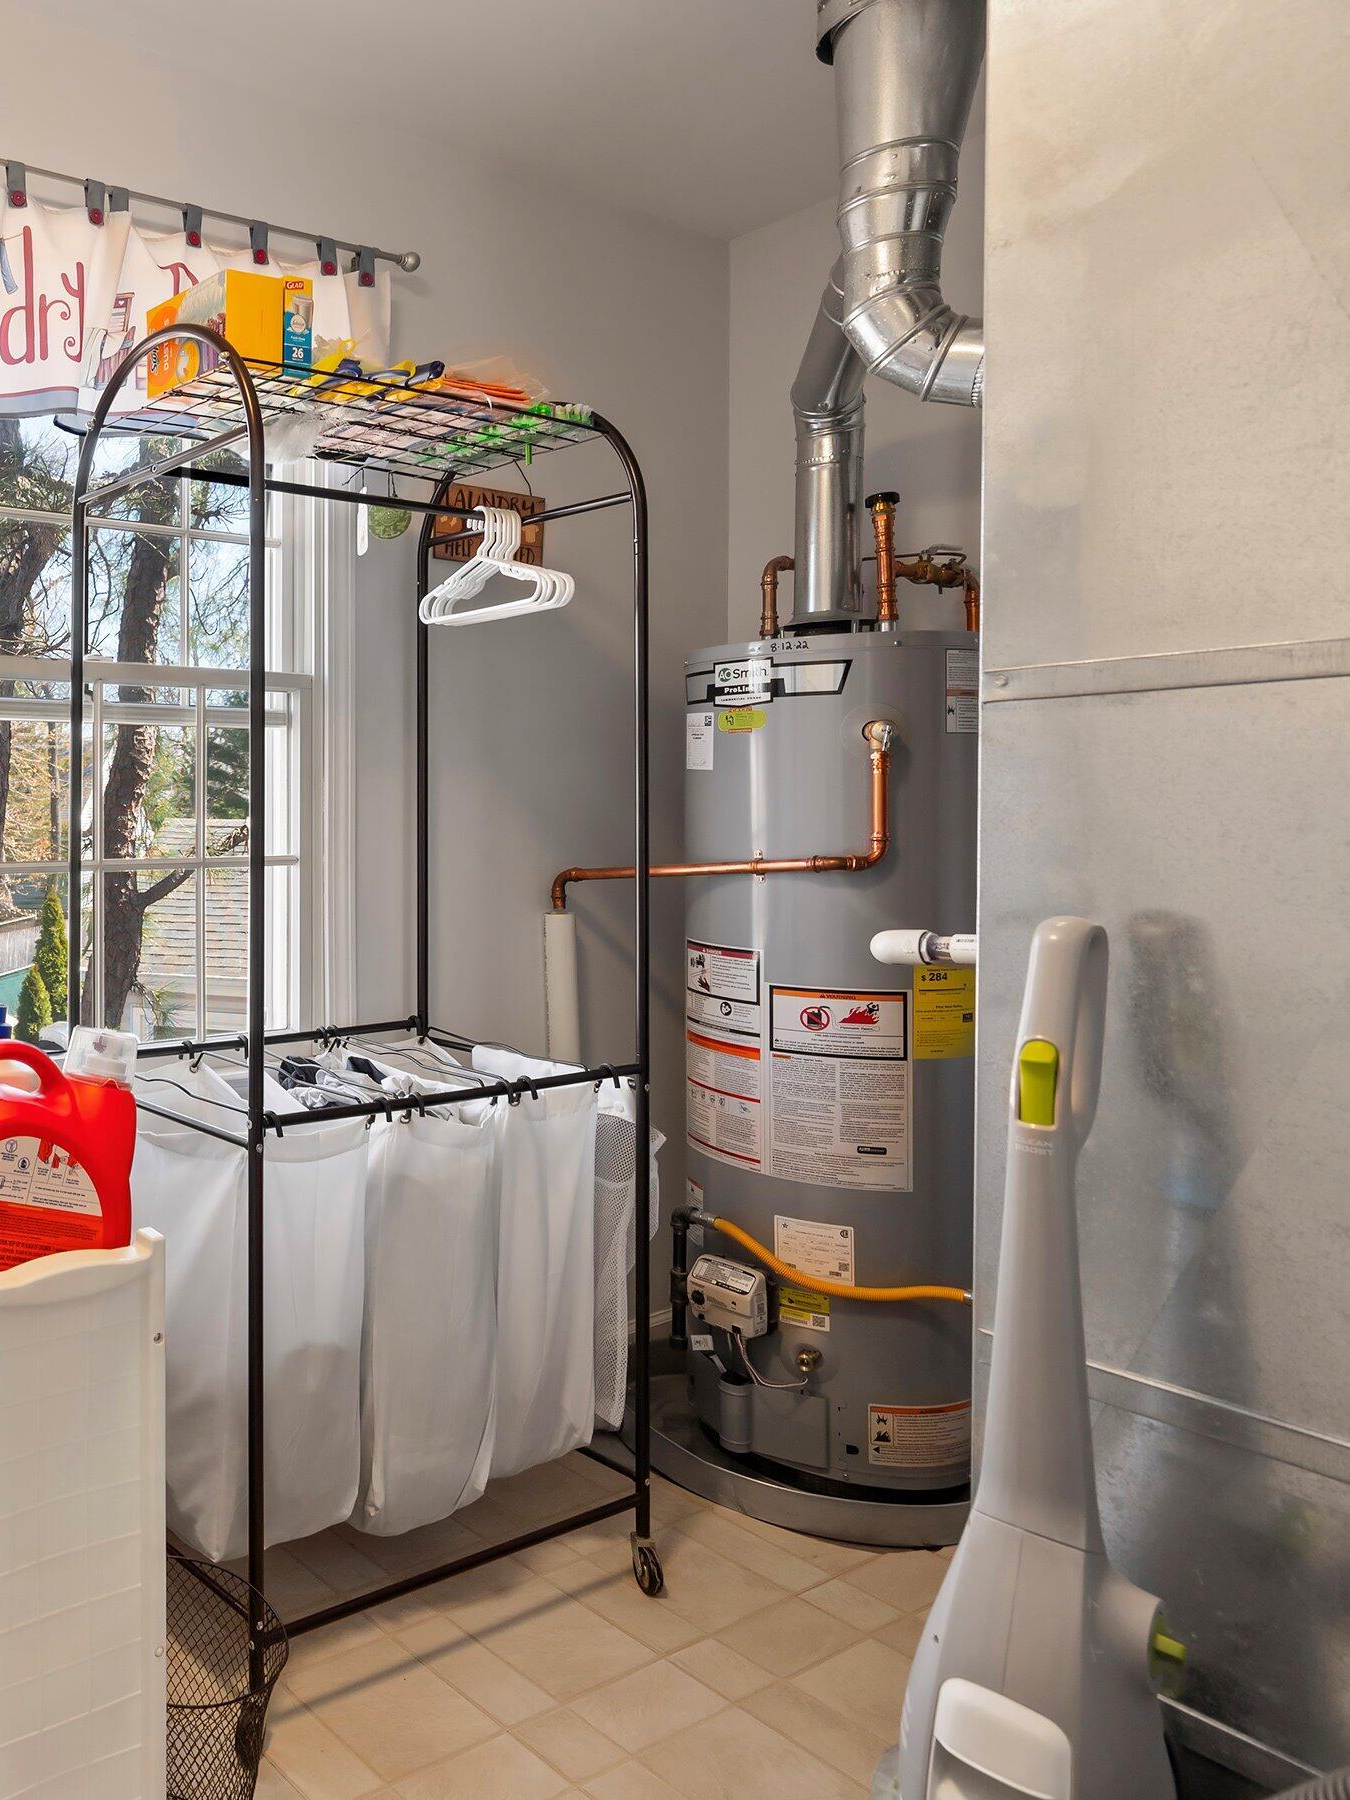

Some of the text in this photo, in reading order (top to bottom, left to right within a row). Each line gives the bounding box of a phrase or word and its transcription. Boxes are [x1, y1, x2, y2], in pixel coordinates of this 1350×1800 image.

[286, 281, 304, 290] GLAD
[163, 318, 171, 371] DUSTS
[292, 347, 304, 359] 26
[444, 539, 474, 560] HELP
[733, 668, 767, 679] Smh
[921, 972, 948, 982] $ 284
